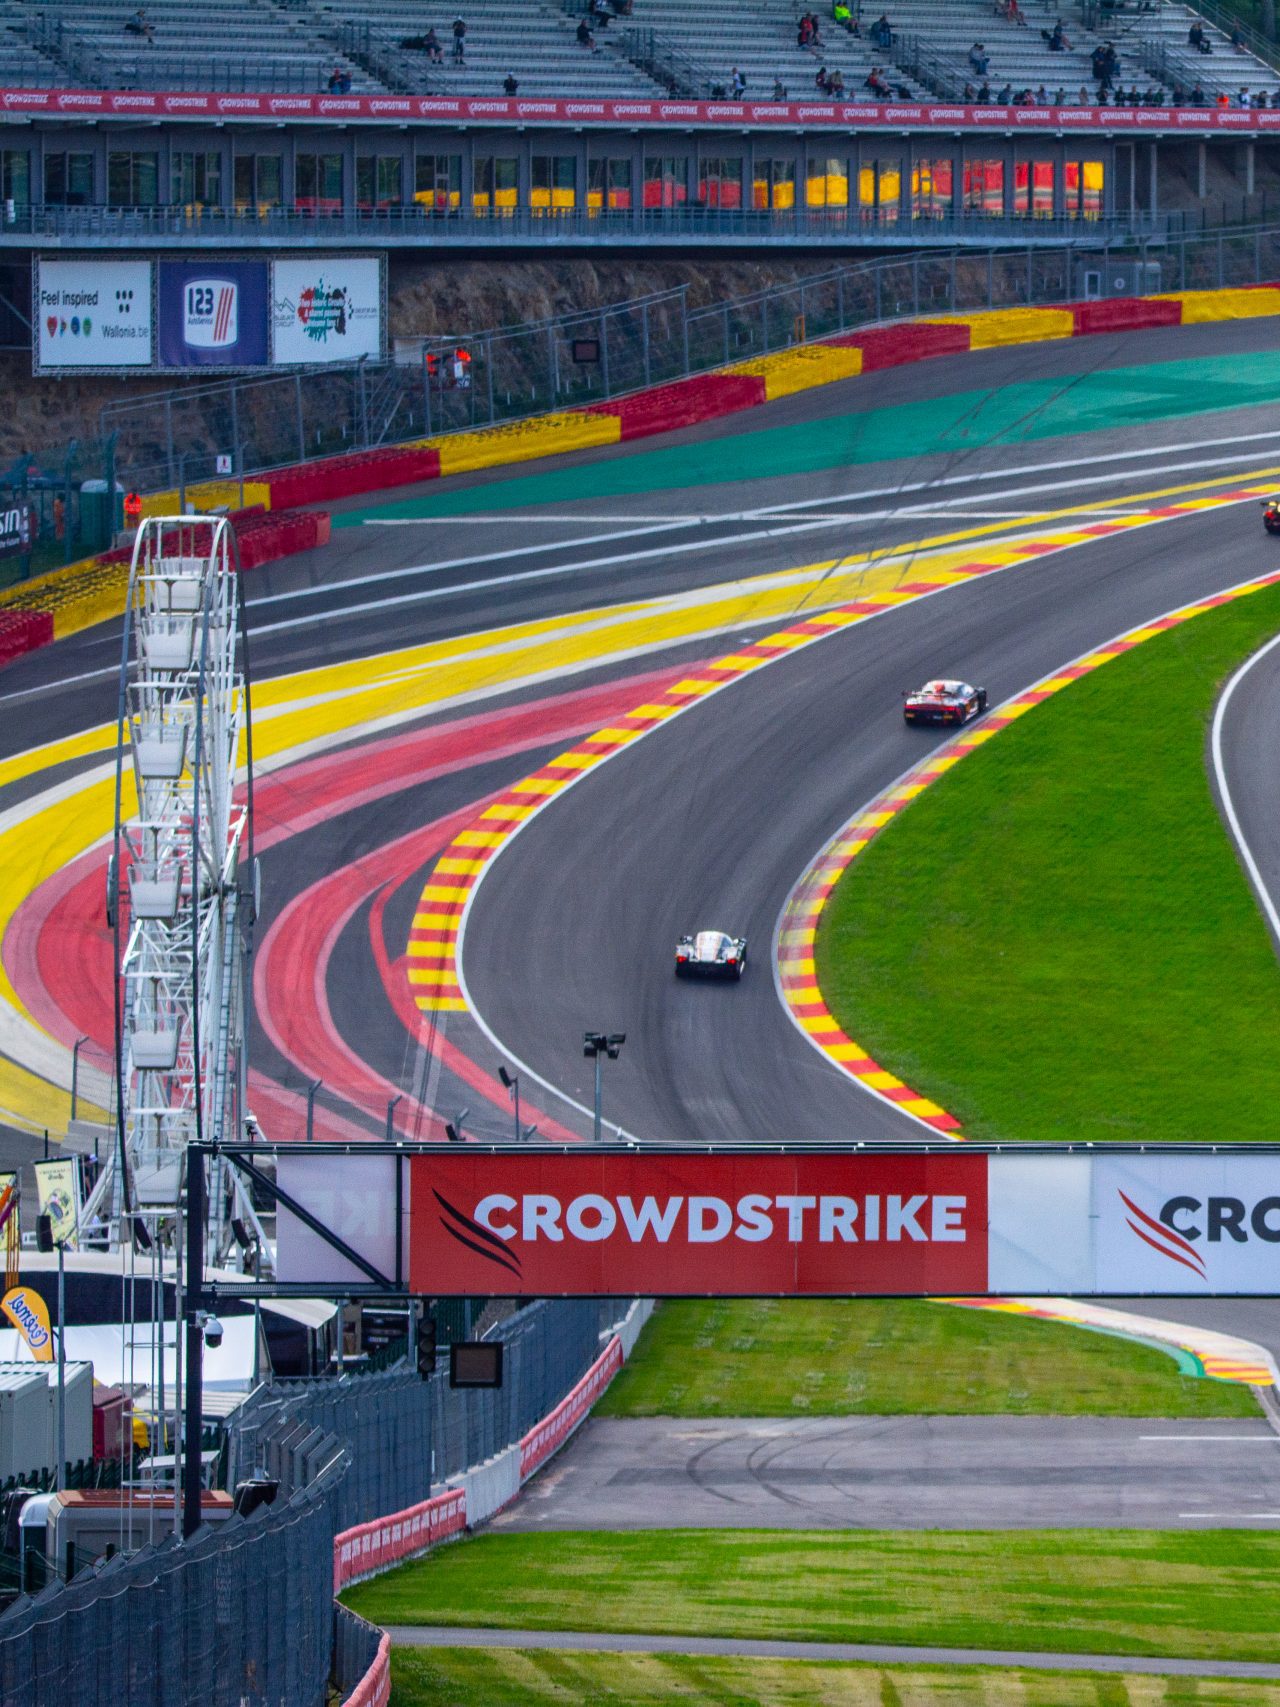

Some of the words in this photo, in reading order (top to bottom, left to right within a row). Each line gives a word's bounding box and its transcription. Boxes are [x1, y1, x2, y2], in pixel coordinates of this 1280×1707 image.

[4, 94, 48, 104] CROWDSTRIKE
[59, 95, 102, 105] CROWDSTRIKE
[113, 96, 155, 106] CROWDSTRIKE
[166, 98, 207, 108] CROWDSTRIKE
[219, 99, 259, 108] CROWDSTRIKE
[270, 99, 311, 109] CROWDSTRIKE
[320, 100, 360, 110] CROWDSTRIKE
[371, 101, 410, 111] CROWDSTRIKE
[420, 102, 459, 111] CROWDSTRIKE
[469, 103, 508, 112] CROWDSTRIKE
[518, 103, 556, 113] CROWDSTRIKE
[567, 105, 604, 114] CROWDSTRIKE
[614, 105, 651, 114] CROWDSTRIKE
[661, 106, 697, 115] CROWDSTRIKE
[708, 107, 743, 116] CROWDSTRIKE
[753, 107, 789, 116] CROWDSTRIKE
[799, 108, 834, 117] CROWDSTRIKE
[41, 290, 60, 305] Feel
[63, 290, 98, 308] inspired
[188, 287, 214, 315] 123
[101, 325, 149, 338] Wallonia.be
[474, 1194, 967, 1242] CROWDSTRIKE
